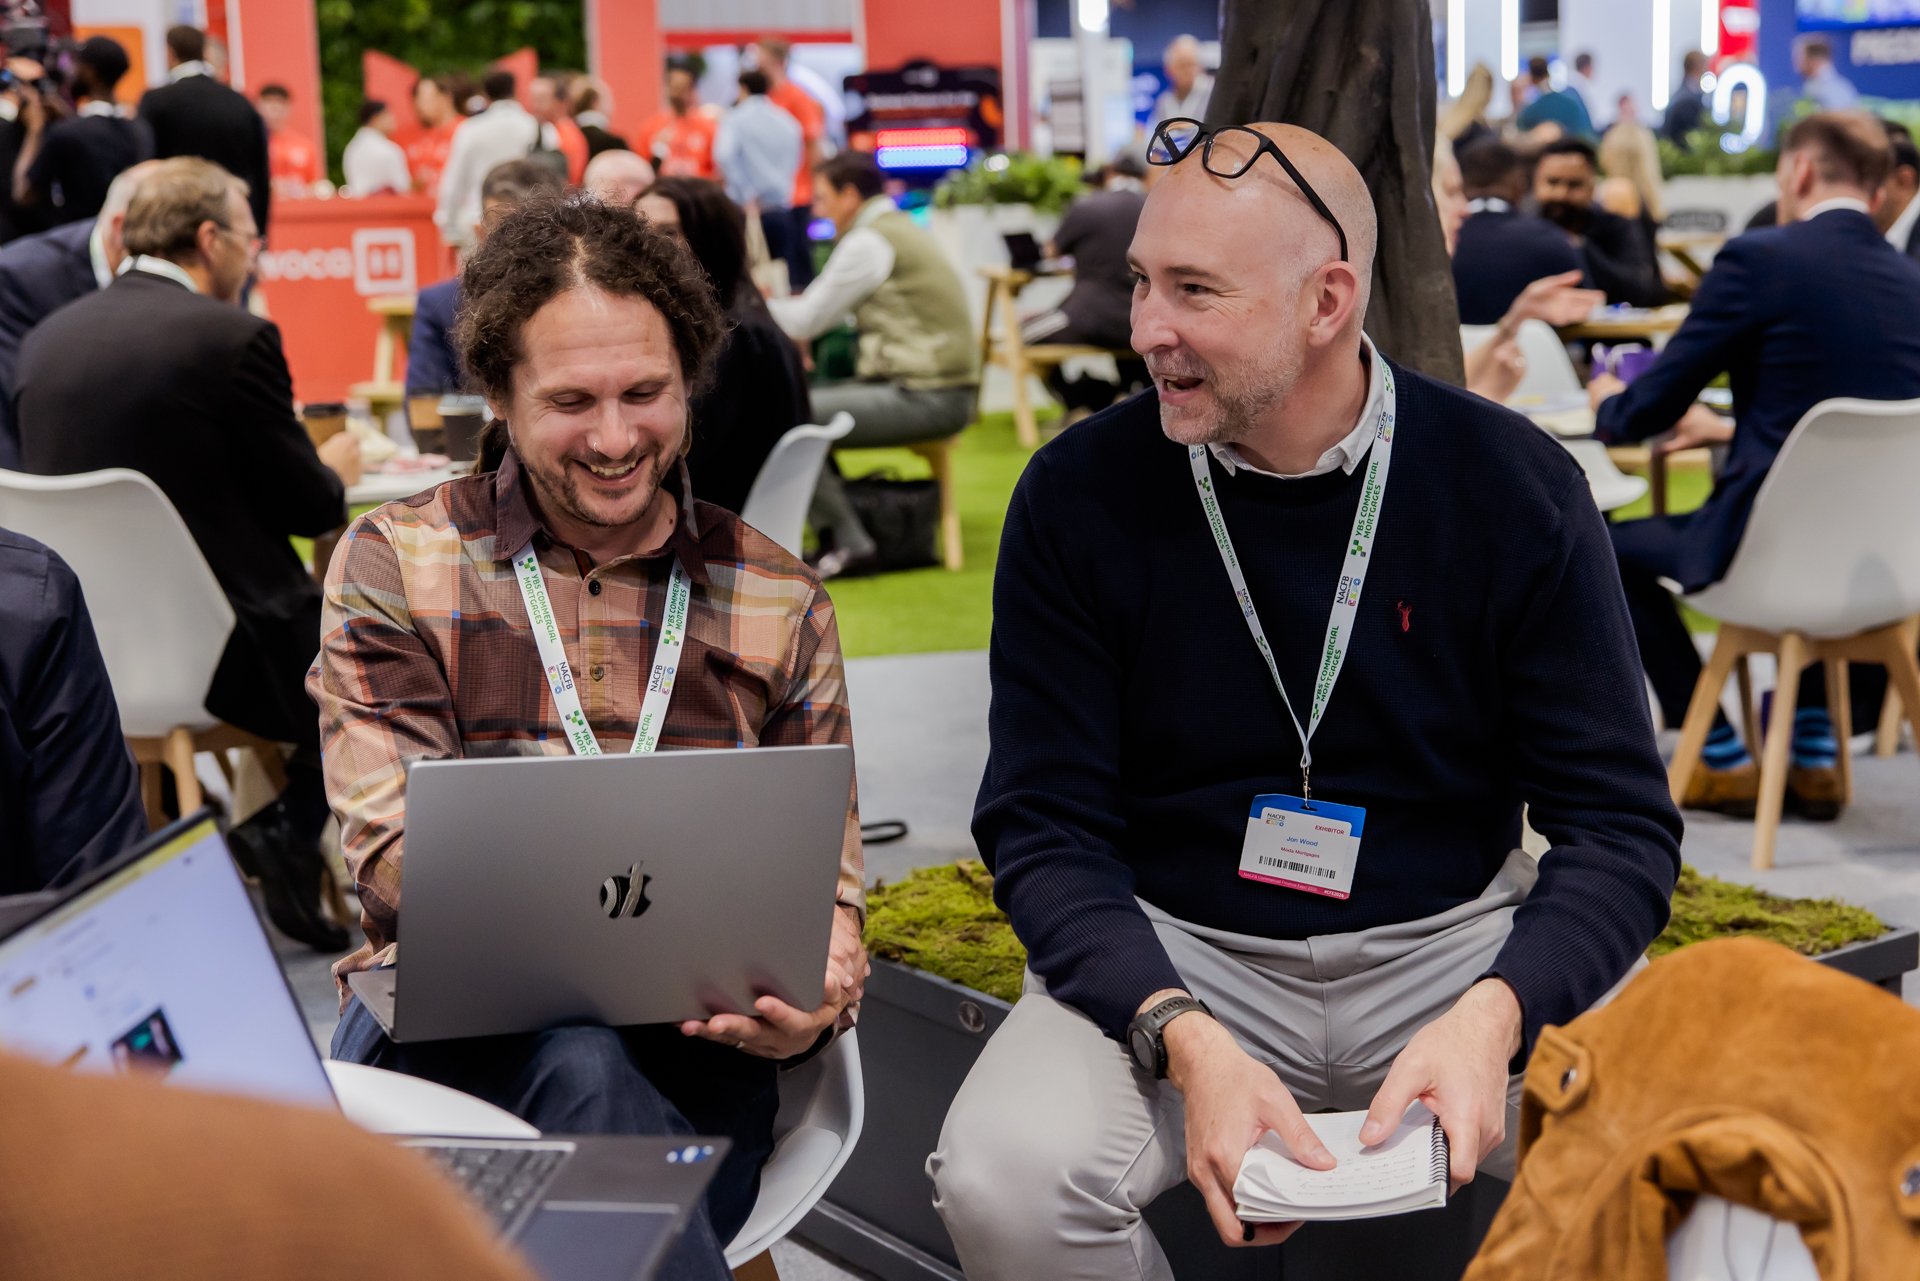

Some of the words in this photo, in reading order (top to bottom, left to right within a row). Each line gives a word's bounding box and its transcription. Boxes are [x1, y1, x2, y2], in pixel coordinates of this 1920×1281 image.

[1356, 519, 1365, 536] YBS
[1361, 460, 1379, 518] COMMERCIAL
[1363, 484, 1381, 539] MORTGAGES
[1203, 498, 1225, 550] MORTGAGES
[1208, 495, 1217, 512] YBS
[1214, 513, 1236, 569] COMMERCIAL
[532, 573, 541, 590] YBS
[1336, 575, 1349, 604] NACFB
[523, 576, 543, 625] MORTGAGES
[536, 590, 557, 644] COMMERCIAL
[675, 589, 687, 631] MORTGAGES
[667, 613, 675, 628] YBS
[1320, 625, 1340, 682] COMMERCIAL
[559, 661, 573, 690] NACFB
[650, 664, 663, 692] NACFB
[1321, 648, 1342, 702] MORTGAGES
[581, 728, 593, 745] YBS
[1267, 812, 1286, 820] NACFB
[1315, 825, 1345, 835] EXHIBITOR
[1300, 838, 1319, 847] Wood
